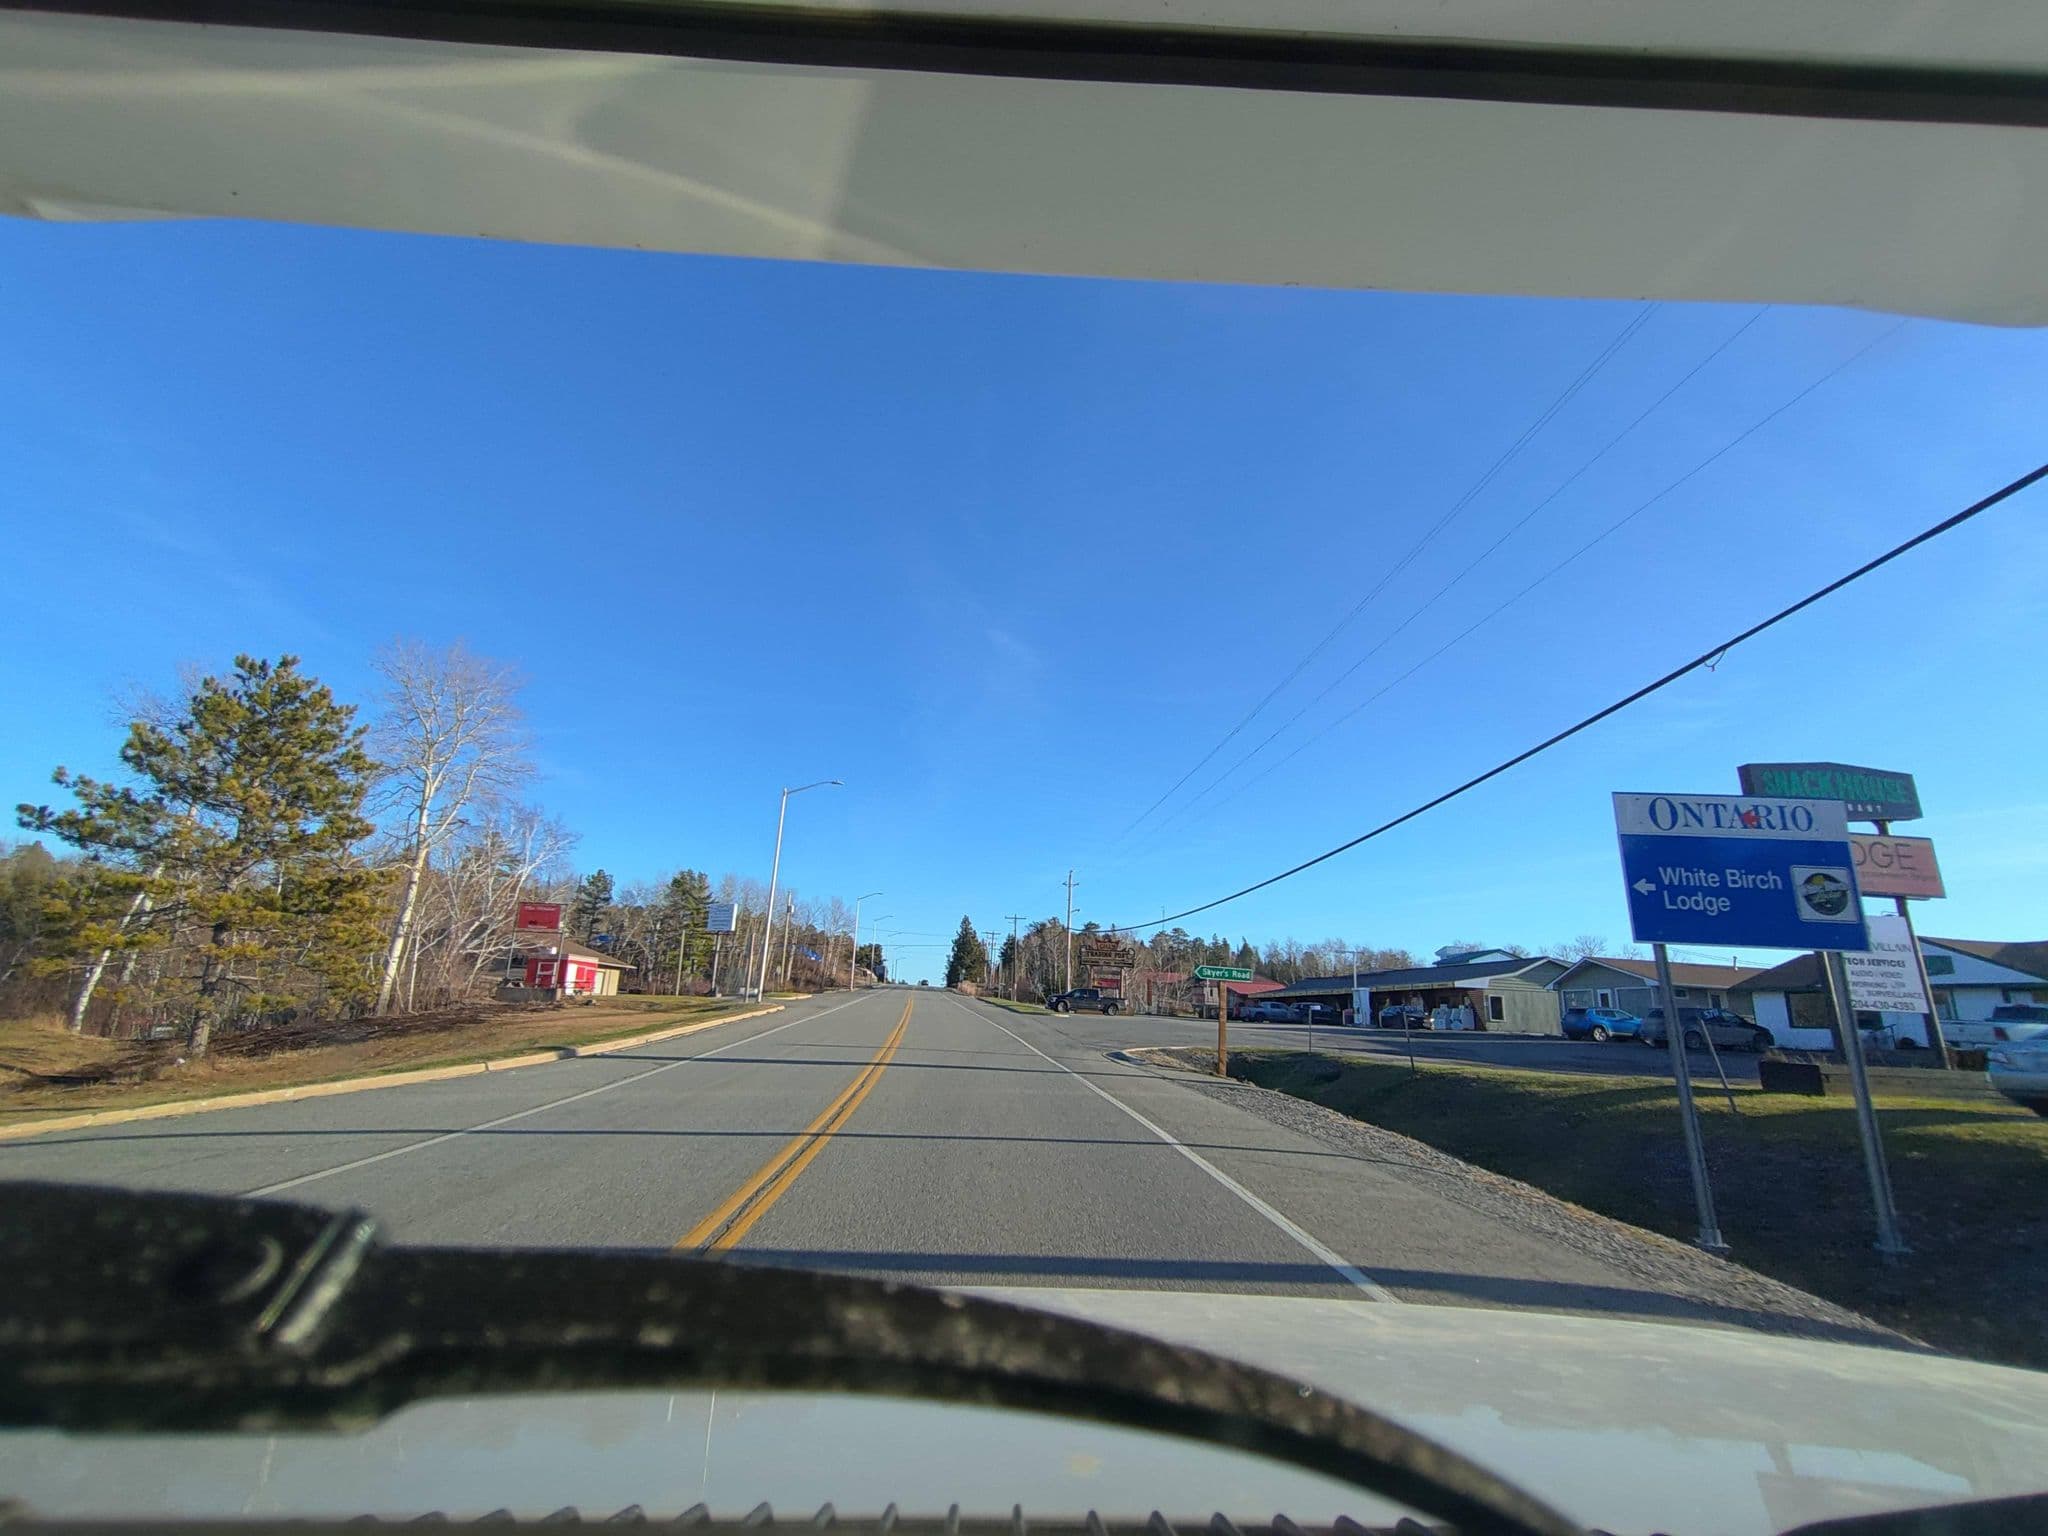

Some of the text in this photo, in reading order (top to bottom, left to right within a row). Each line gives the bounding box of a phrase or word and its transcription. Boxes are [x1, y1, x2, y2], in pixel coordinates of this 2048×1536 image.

[1649, 797, 1814, 832] ONTARIO
[1658, 866, 1783, 890] White Birch
[1664, 890, 1731, 916] Lodge
[1232, 970, 1250, 979] Road
